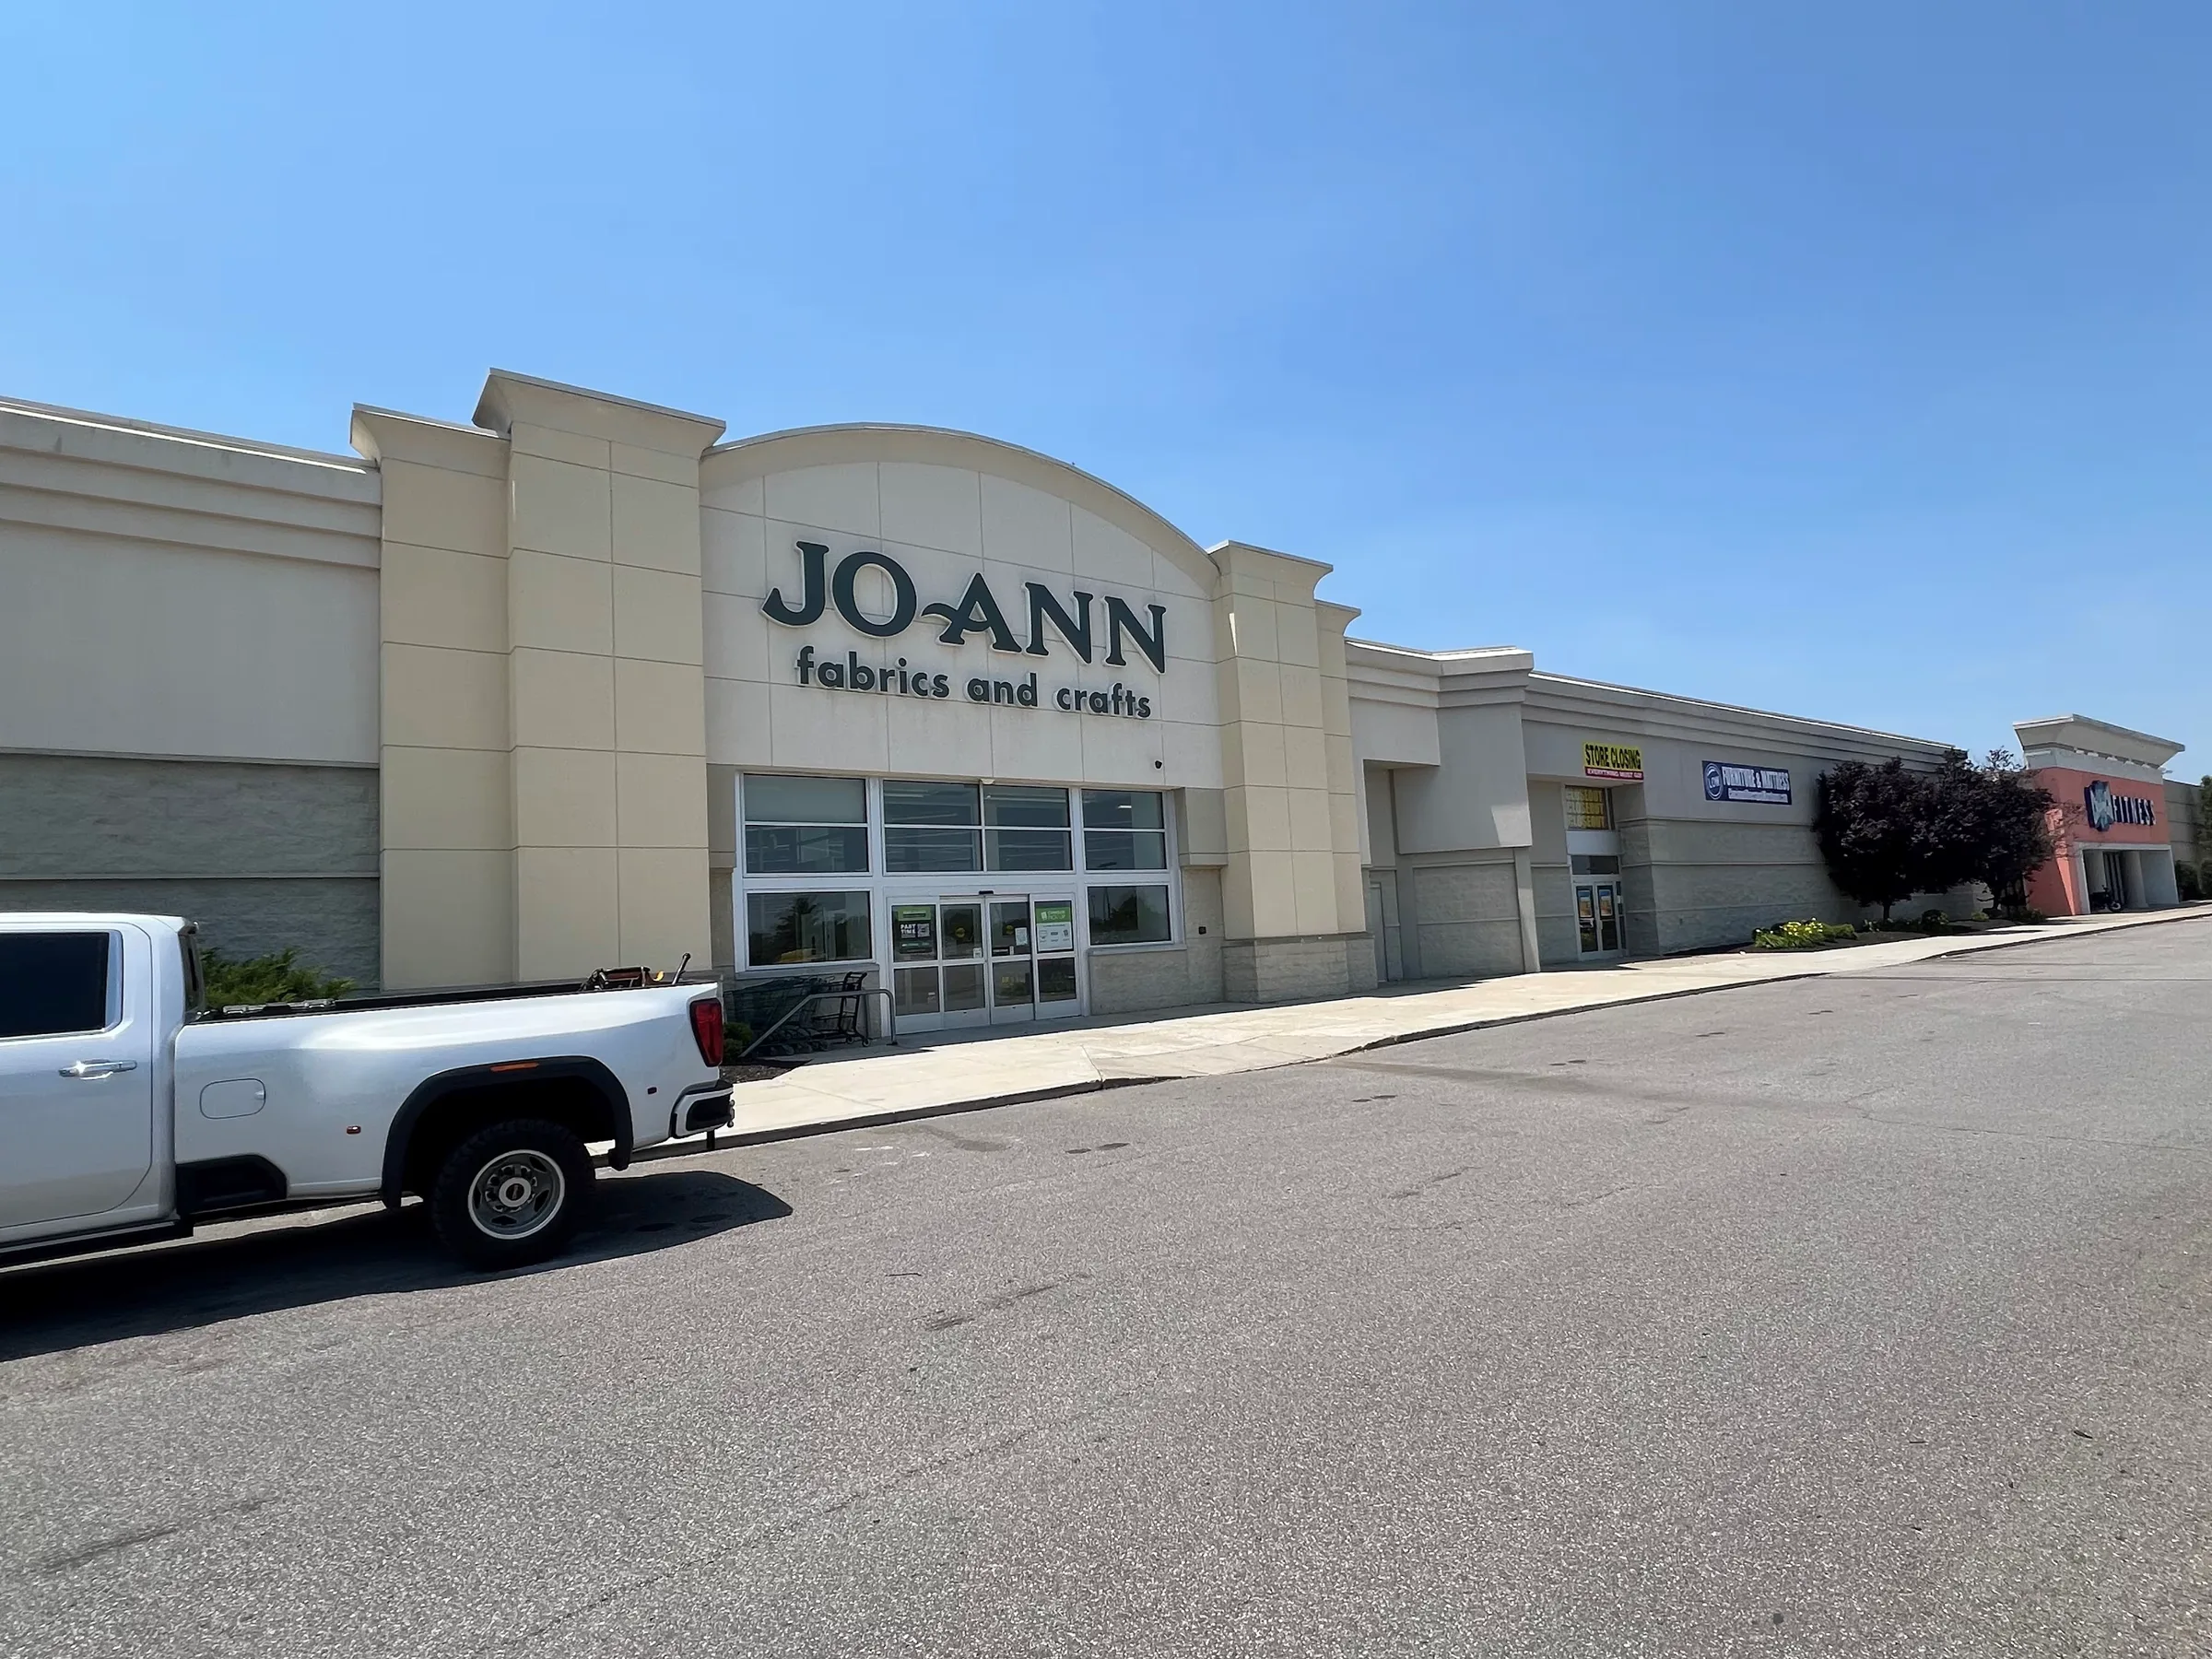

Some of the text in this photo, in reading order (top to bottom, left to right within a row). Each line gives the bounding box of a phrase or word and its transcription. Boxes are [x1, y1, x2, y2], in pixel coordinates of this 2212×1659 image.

[796, 646, 1151, 718] fabrics and crafts
[1585, 744, 1641, 770] STORE CLOSING
[1755, 772, 1761, 788] &
[2111, 794, 2156, 825] FITNESS
